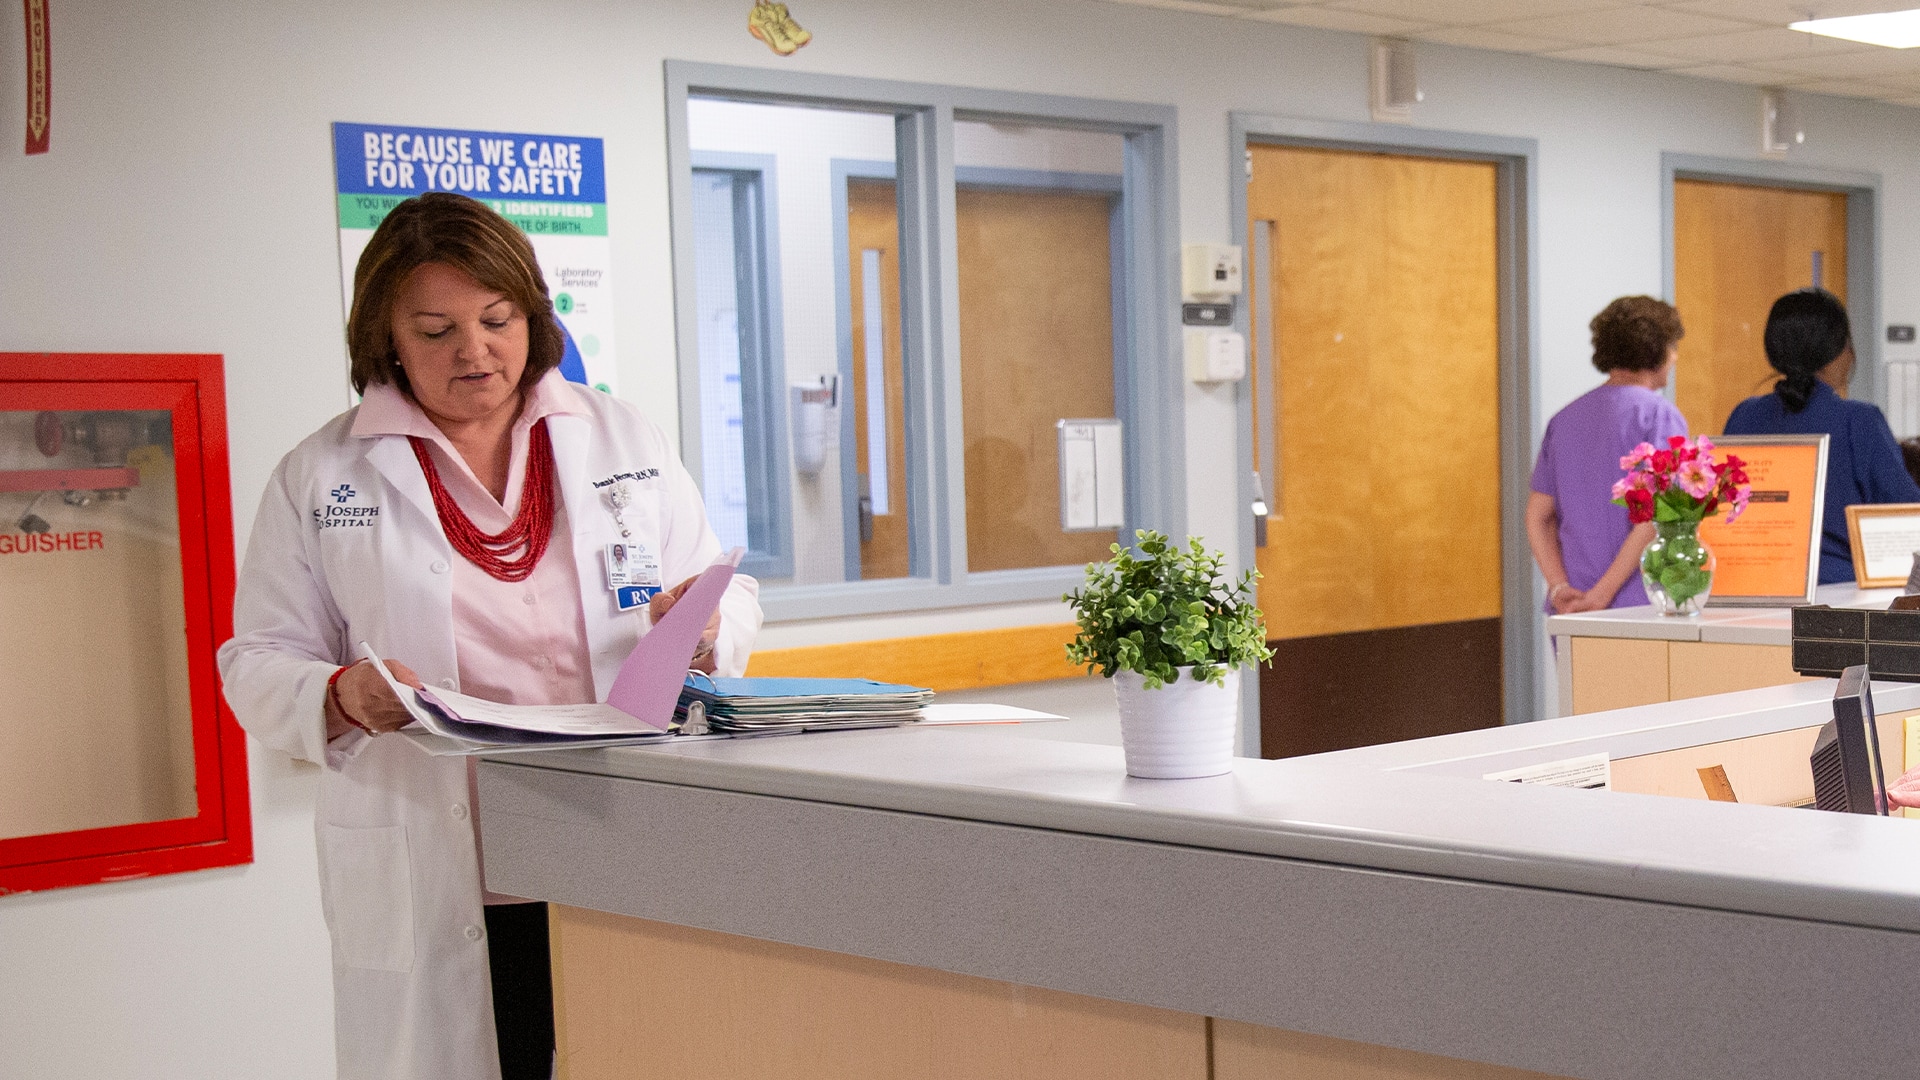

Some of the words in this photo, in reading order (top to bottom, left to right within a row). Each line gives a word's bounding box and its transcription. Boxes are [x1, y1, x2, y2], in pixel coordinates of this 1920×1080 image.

[33, 0, 42, 130] NGUISHER
[363, 132, 474, 165] BECAUSE
[479, 138, 517, 167] WE
[522, 141, 583, 170] CARE
[365, 159, 415, 188] FOR
[423, 163, 492, 192] YOUR
[499, 167, 583, 196] SAFETY
[356, 197, 379, 210] YOU
[505, 203, 594, 218] IDENTIFIERS
[535, 221, 547, 232] OF
[555, 267, 603, 279] Laboratory
[561, 278, 599, 288] Services
[561, 298, 568, 310] 2
[324, 505, 379, 519] JOSEPH
[316, 518, 374, 529] OSPITAL
[631, 588, 651, 605] RN
